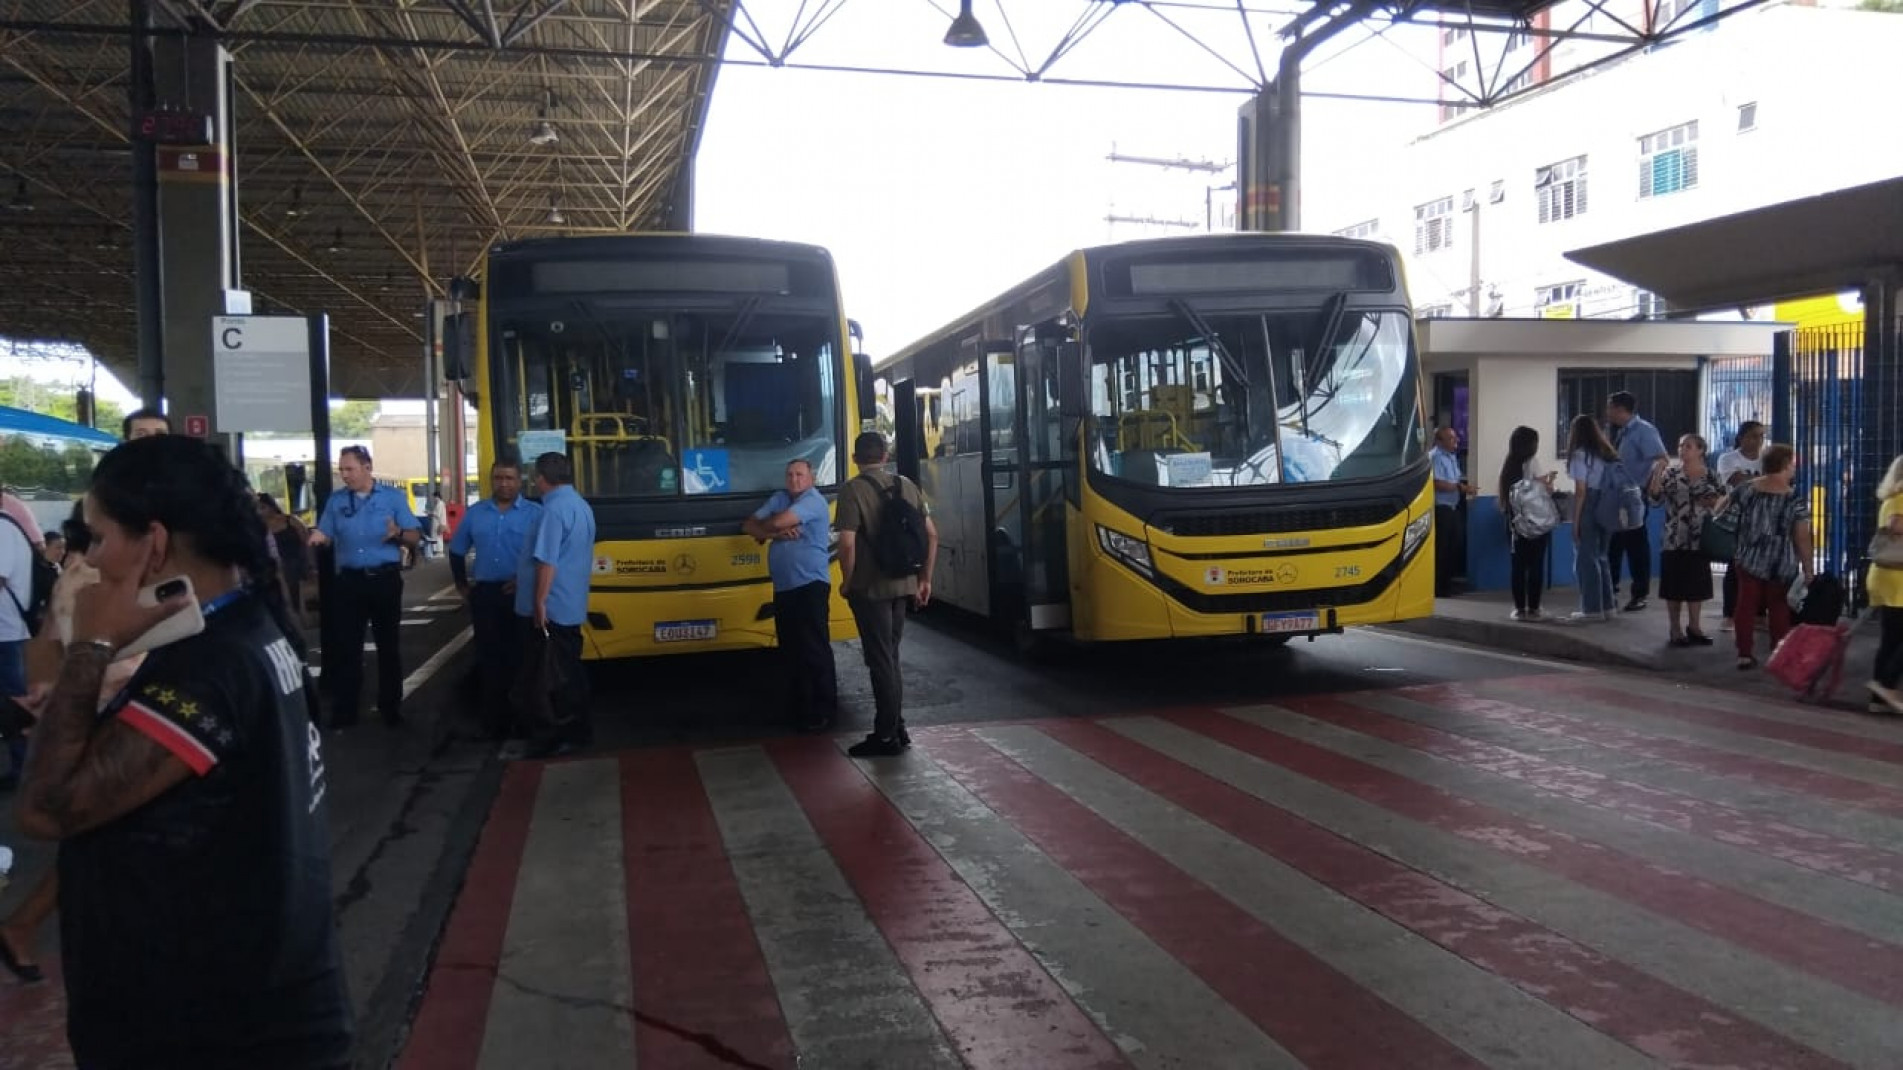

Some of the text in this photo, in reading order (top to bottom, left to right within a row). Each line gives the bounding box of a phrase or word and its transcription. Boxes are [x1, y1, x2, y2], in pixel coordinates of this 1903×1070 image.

[222, 327, 242, 350] C
[1334, 564, 1361, 579] 2745
[1227, 575, 1274, 584] SOROCABA
